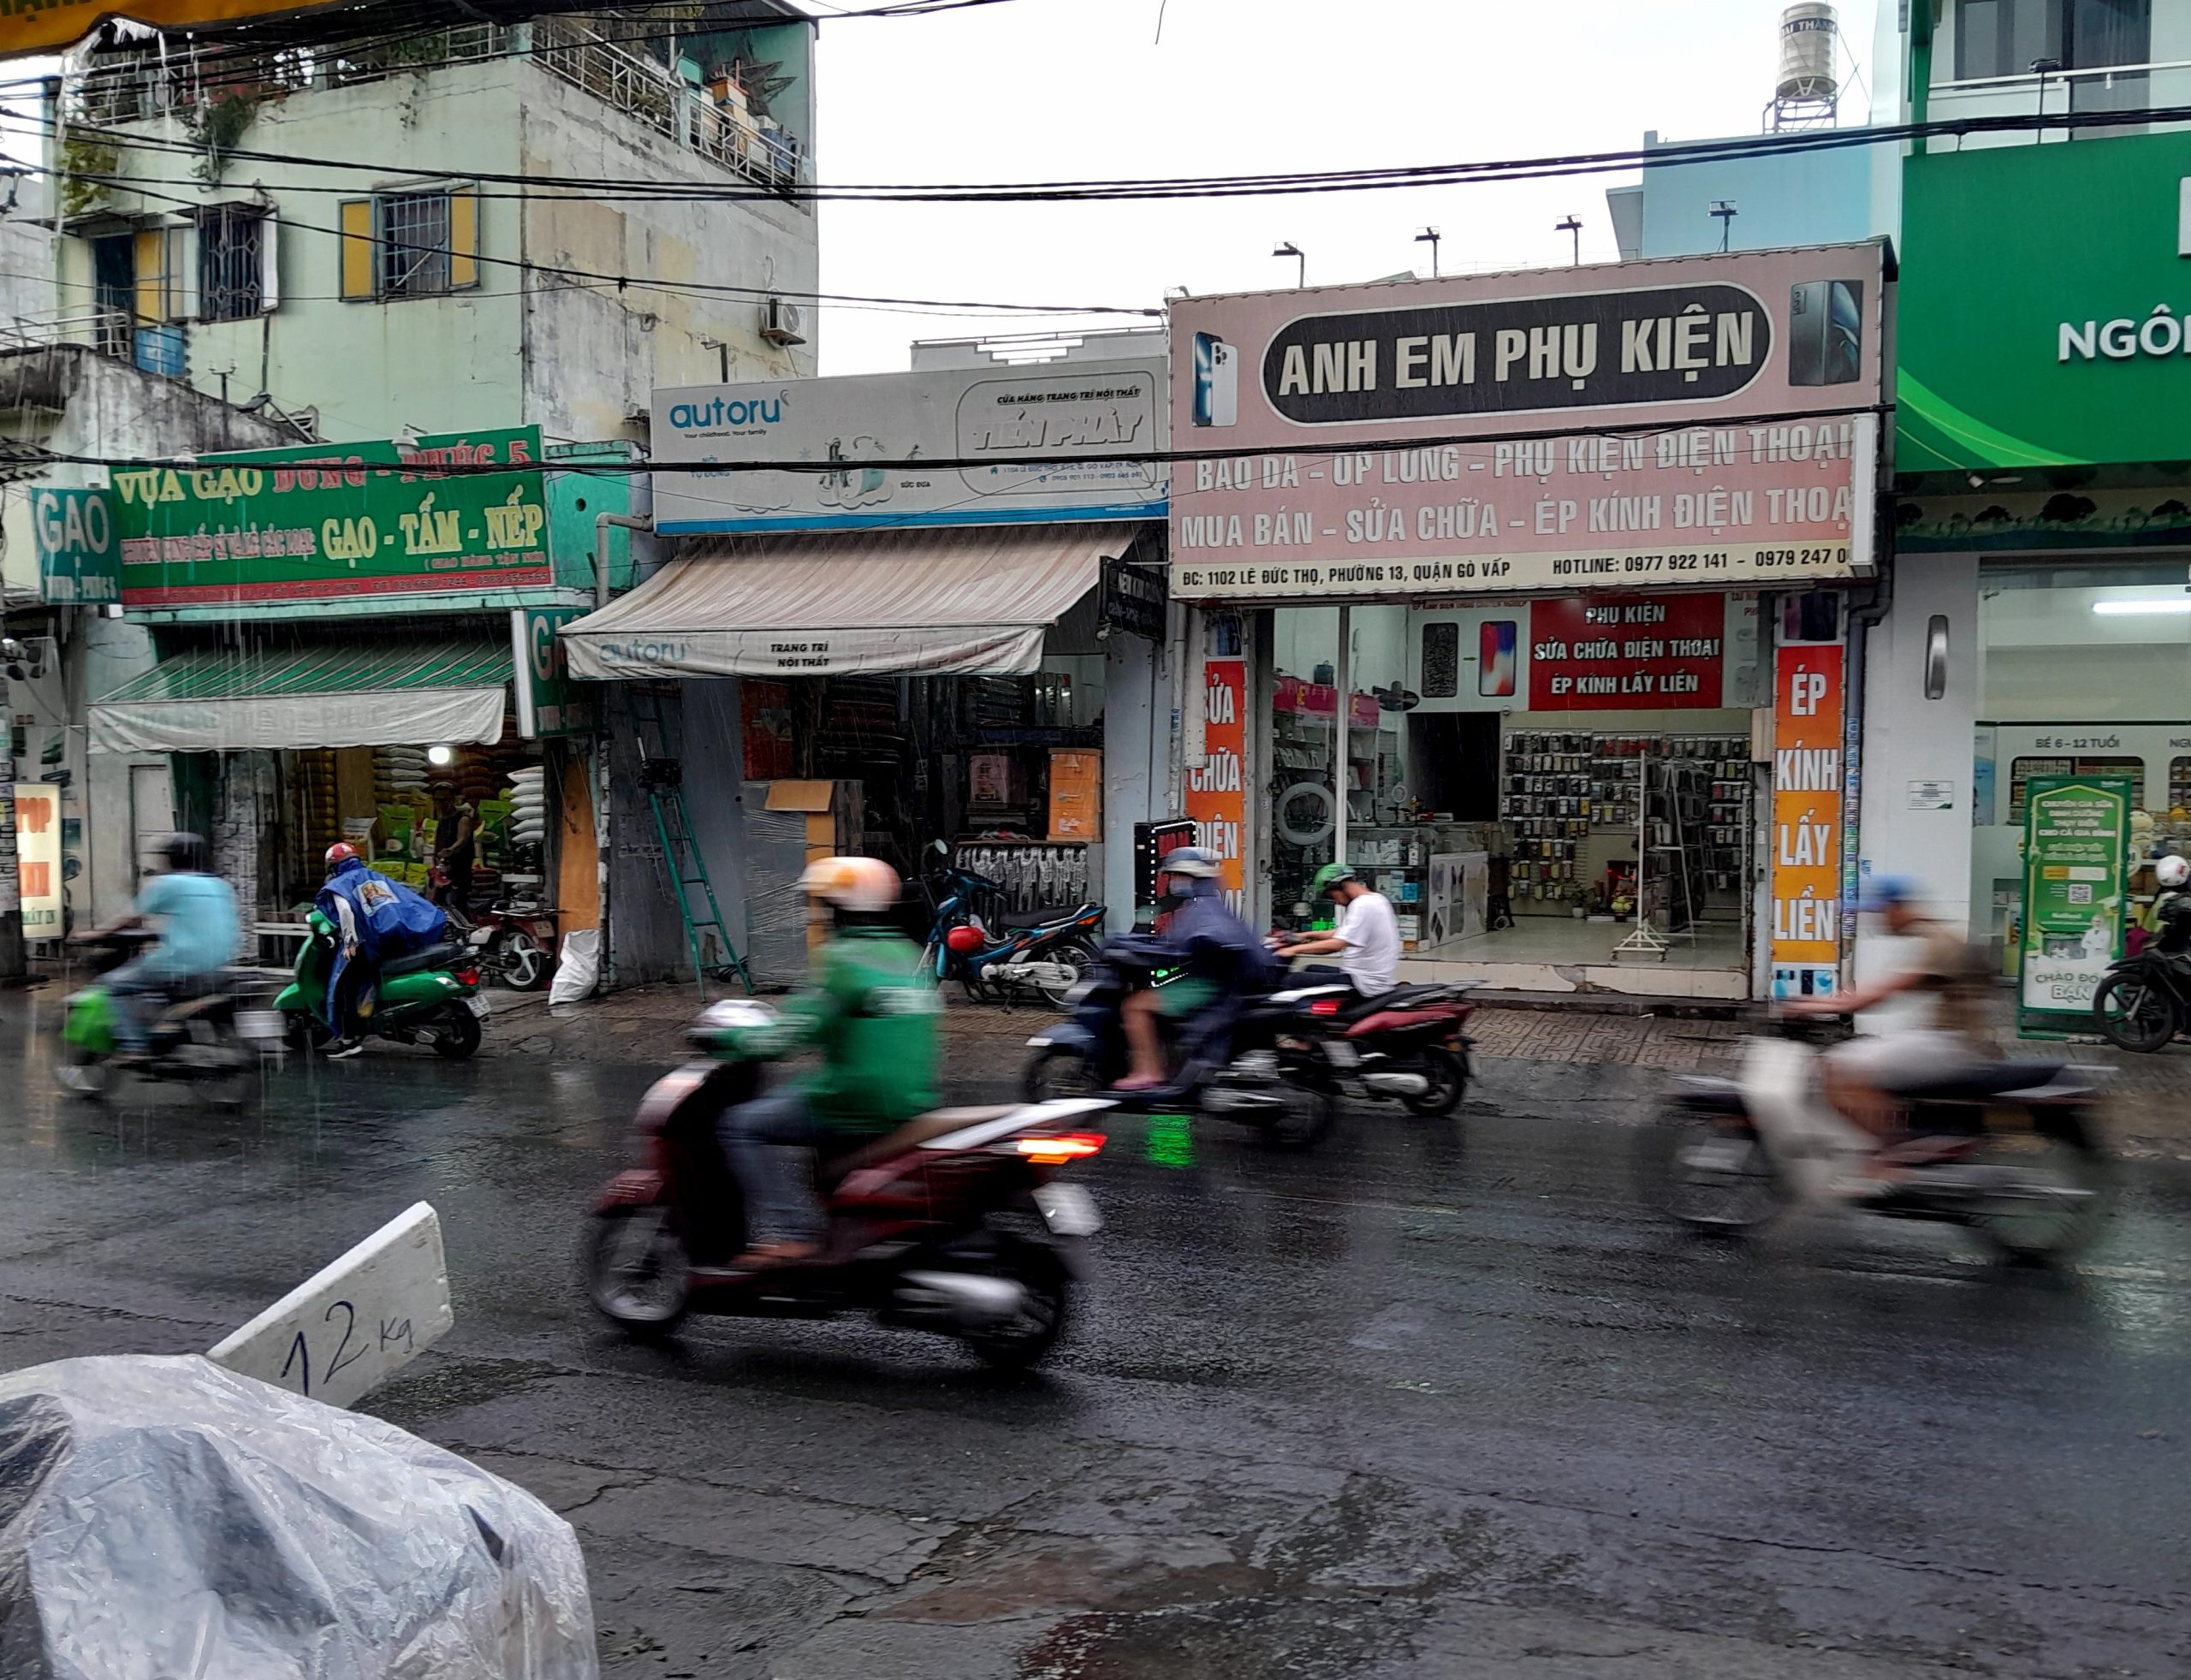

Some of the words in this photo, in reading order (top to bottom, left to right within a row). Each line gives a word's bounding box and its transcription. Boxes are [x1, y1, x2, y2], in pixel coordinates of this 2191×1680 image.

[1279, 341, 1376, 395] ANH
[1395, 333, 1475, 389] EM
[1495, 324, 1598, 390] PHỤ
[1621, 303, 1753, 383] KIỆN
[669, 396, 781, 429] autoru
[1046, 390, 1077, 401] TRANG
[1079, 388, 1094, 399] TRÍ
[1195, 458, 1251, 492] BAO
[1262, 454, 1299, 489] DA
[1493, 442, 1554, 484] PHỤ
[1655, 426, 1735, 476] ĐIỆN
[1747, 424, 1850, 470] THOẠI
[114, 467, 186, 509] VỰA
[192, 468, 263, 505] GẠO
[36, 492, 110, 568] GẠO
[322, 516, 377, 568] GẠO
[399, 491, 463, 555] TẤM
[484, 484, 543, 549] NẾP
[1180, 515, 1244, 549] MUA
[1253, 506, 1313, 547] BÁN
[1345, 497, 1406, 544] SỬA
[1416, 498, 1499, 541] CHỮA
[1535, 493, 1577, 536] ÉP
[1588, 490, 1661, 533] KÍNH
[1673, 485, 1754, 536] ĐIỆN
[1766, 486, 1850, 531] THOẠ
[1183, 571, 1203, 585] ĐC:
[1207, 570, 1236, 585] 1102
[1240, 567, 1256, 585] LÊ
[1262, 564, 1289, 584] ĐỨC
[1294, 567, 1324, 586] THỌ,
[1328, 561, 1384, 583] PHƯỜNG
[1388, 566, 1409, 582] 13,
[1413, 561, 1452, 581] QUẬN
[1457, 561, 1476, 579] GÒ
[1481, 559, 1511, 578] VẤP
[1553, 557, 1620, 575] HOTLINE:
[1625, 555, 1664, 573] 0977
[1668, 554, 1698, 570] 922
[1703, 553, 1729, 569] 141
[1755, 550, 1795, 567] 0979
[1801, 548, 1832, 565] 247
[1585, 607, 1620, 629] PHỤ
[1625, 603, 1666, 627] KIỆN
[600, 638, 686, 662] autoru
[769, 642, 810, 654] TRANG
[814, 639, 829, 652] TRÍ
[777, 657, 800, 670] NỘI
[803, 655, 829, 668] THẤT
[1534, 636, 1568, 661] SỬA
[1573, 638, 1618, 659] CHỮA
[1624, 636, 1664, 662] ĐIỆN
[1669, 638, 1720, 665] THOẠI
[1551, 672, 1572, 694] ÉP
[1576, 672, 1617, 694] KÍNH
[1621, 669, 1654, 692] LẤY
[1660, 668, 1699, 692] LIỀN
[1790, 664, 1827, 715] ÉP
[2035, 735, 2051, 748] BÉ
[2073, 739, 2087, 748] 12
[1776, 740, 1838, 791] KÍNH
[1778, 808, 1832, 866] LẤY
[1773, 883, 1836, 941] LIỀN
[2051, 984, 2091, 1004] BẠN
[280, 1300, 369, 1398] 12
